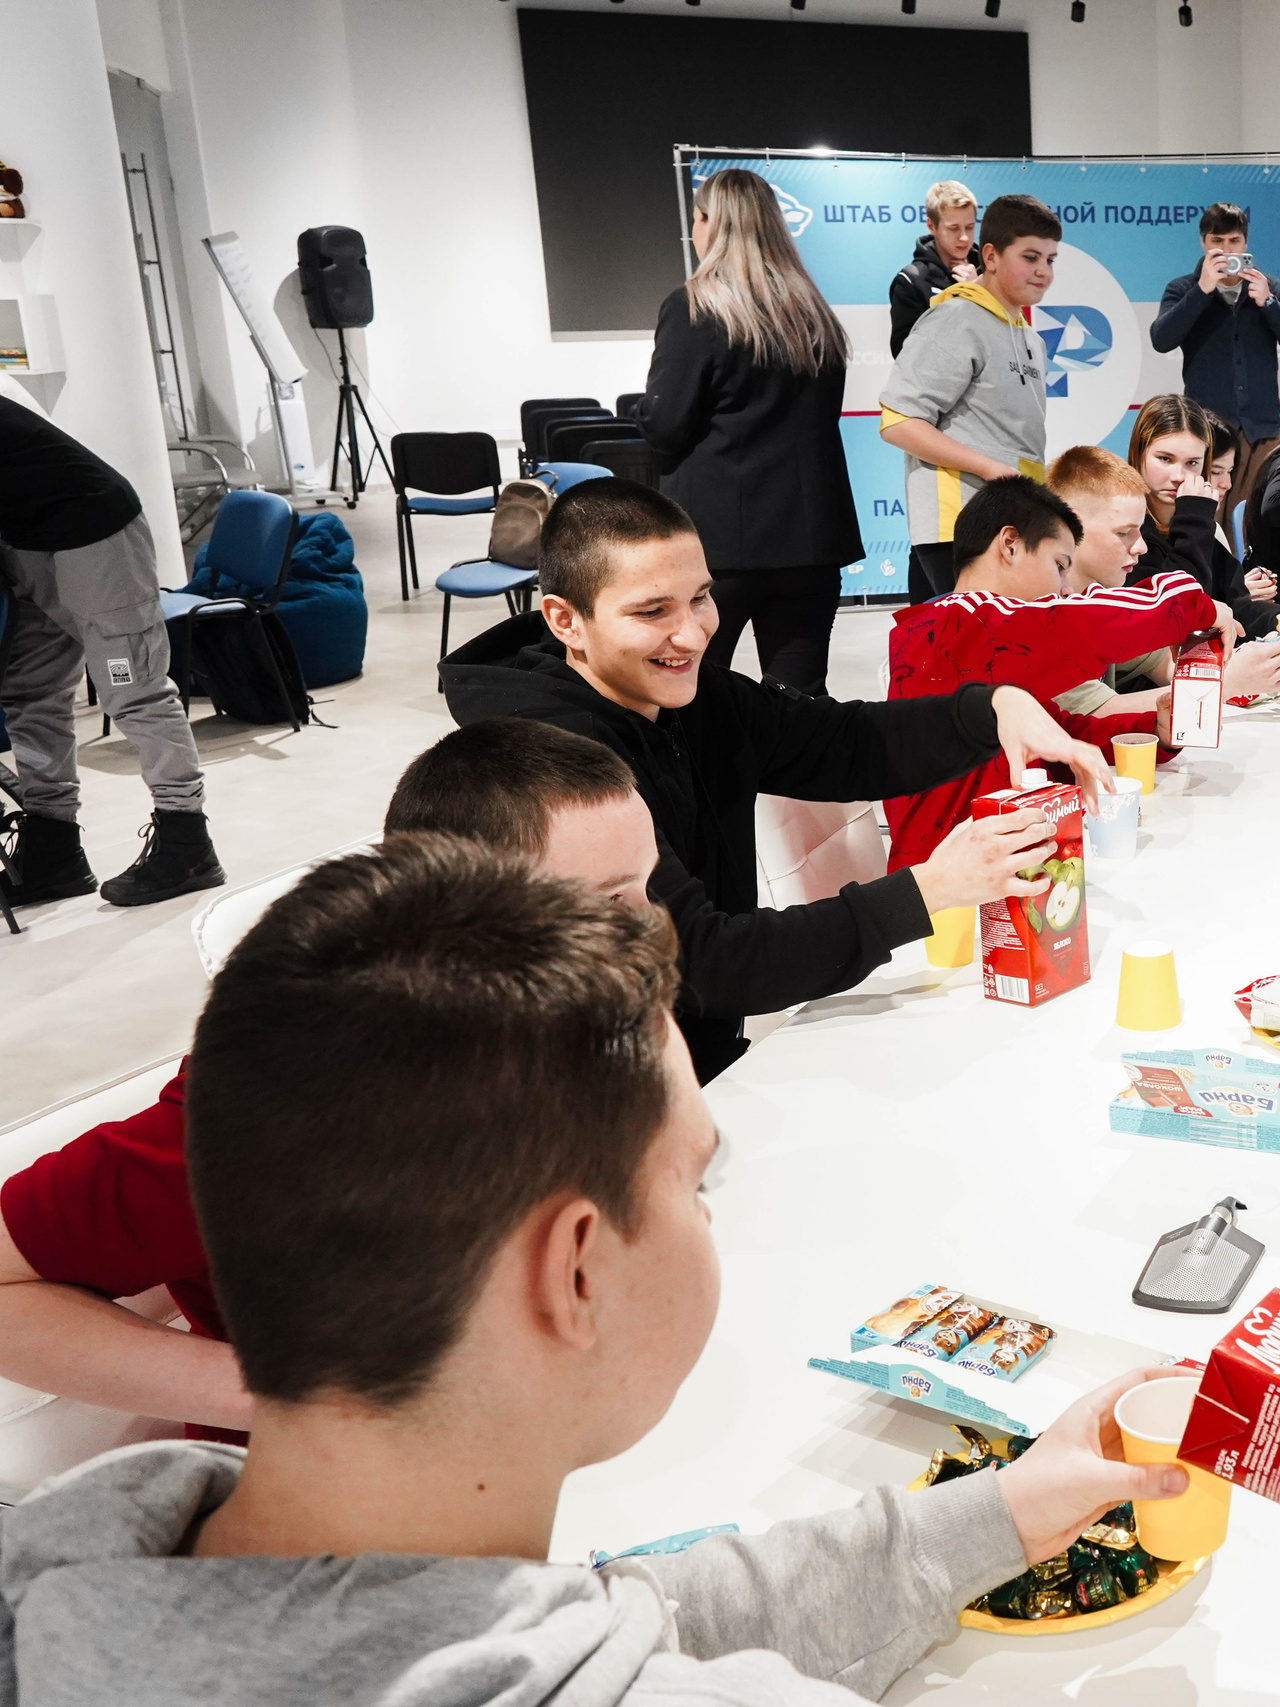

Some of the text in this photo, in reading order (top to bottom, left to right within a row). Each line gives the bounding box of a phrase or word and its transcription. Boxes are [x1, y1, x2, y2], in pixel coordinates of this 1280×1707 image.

[824, 205, 891, 223] ШТАБ
[1205, 1054, 1232, 1065] Барни
[1199, 1091, 1274, 1112] Барни
[902, 1374, 932, 1394] Барни
